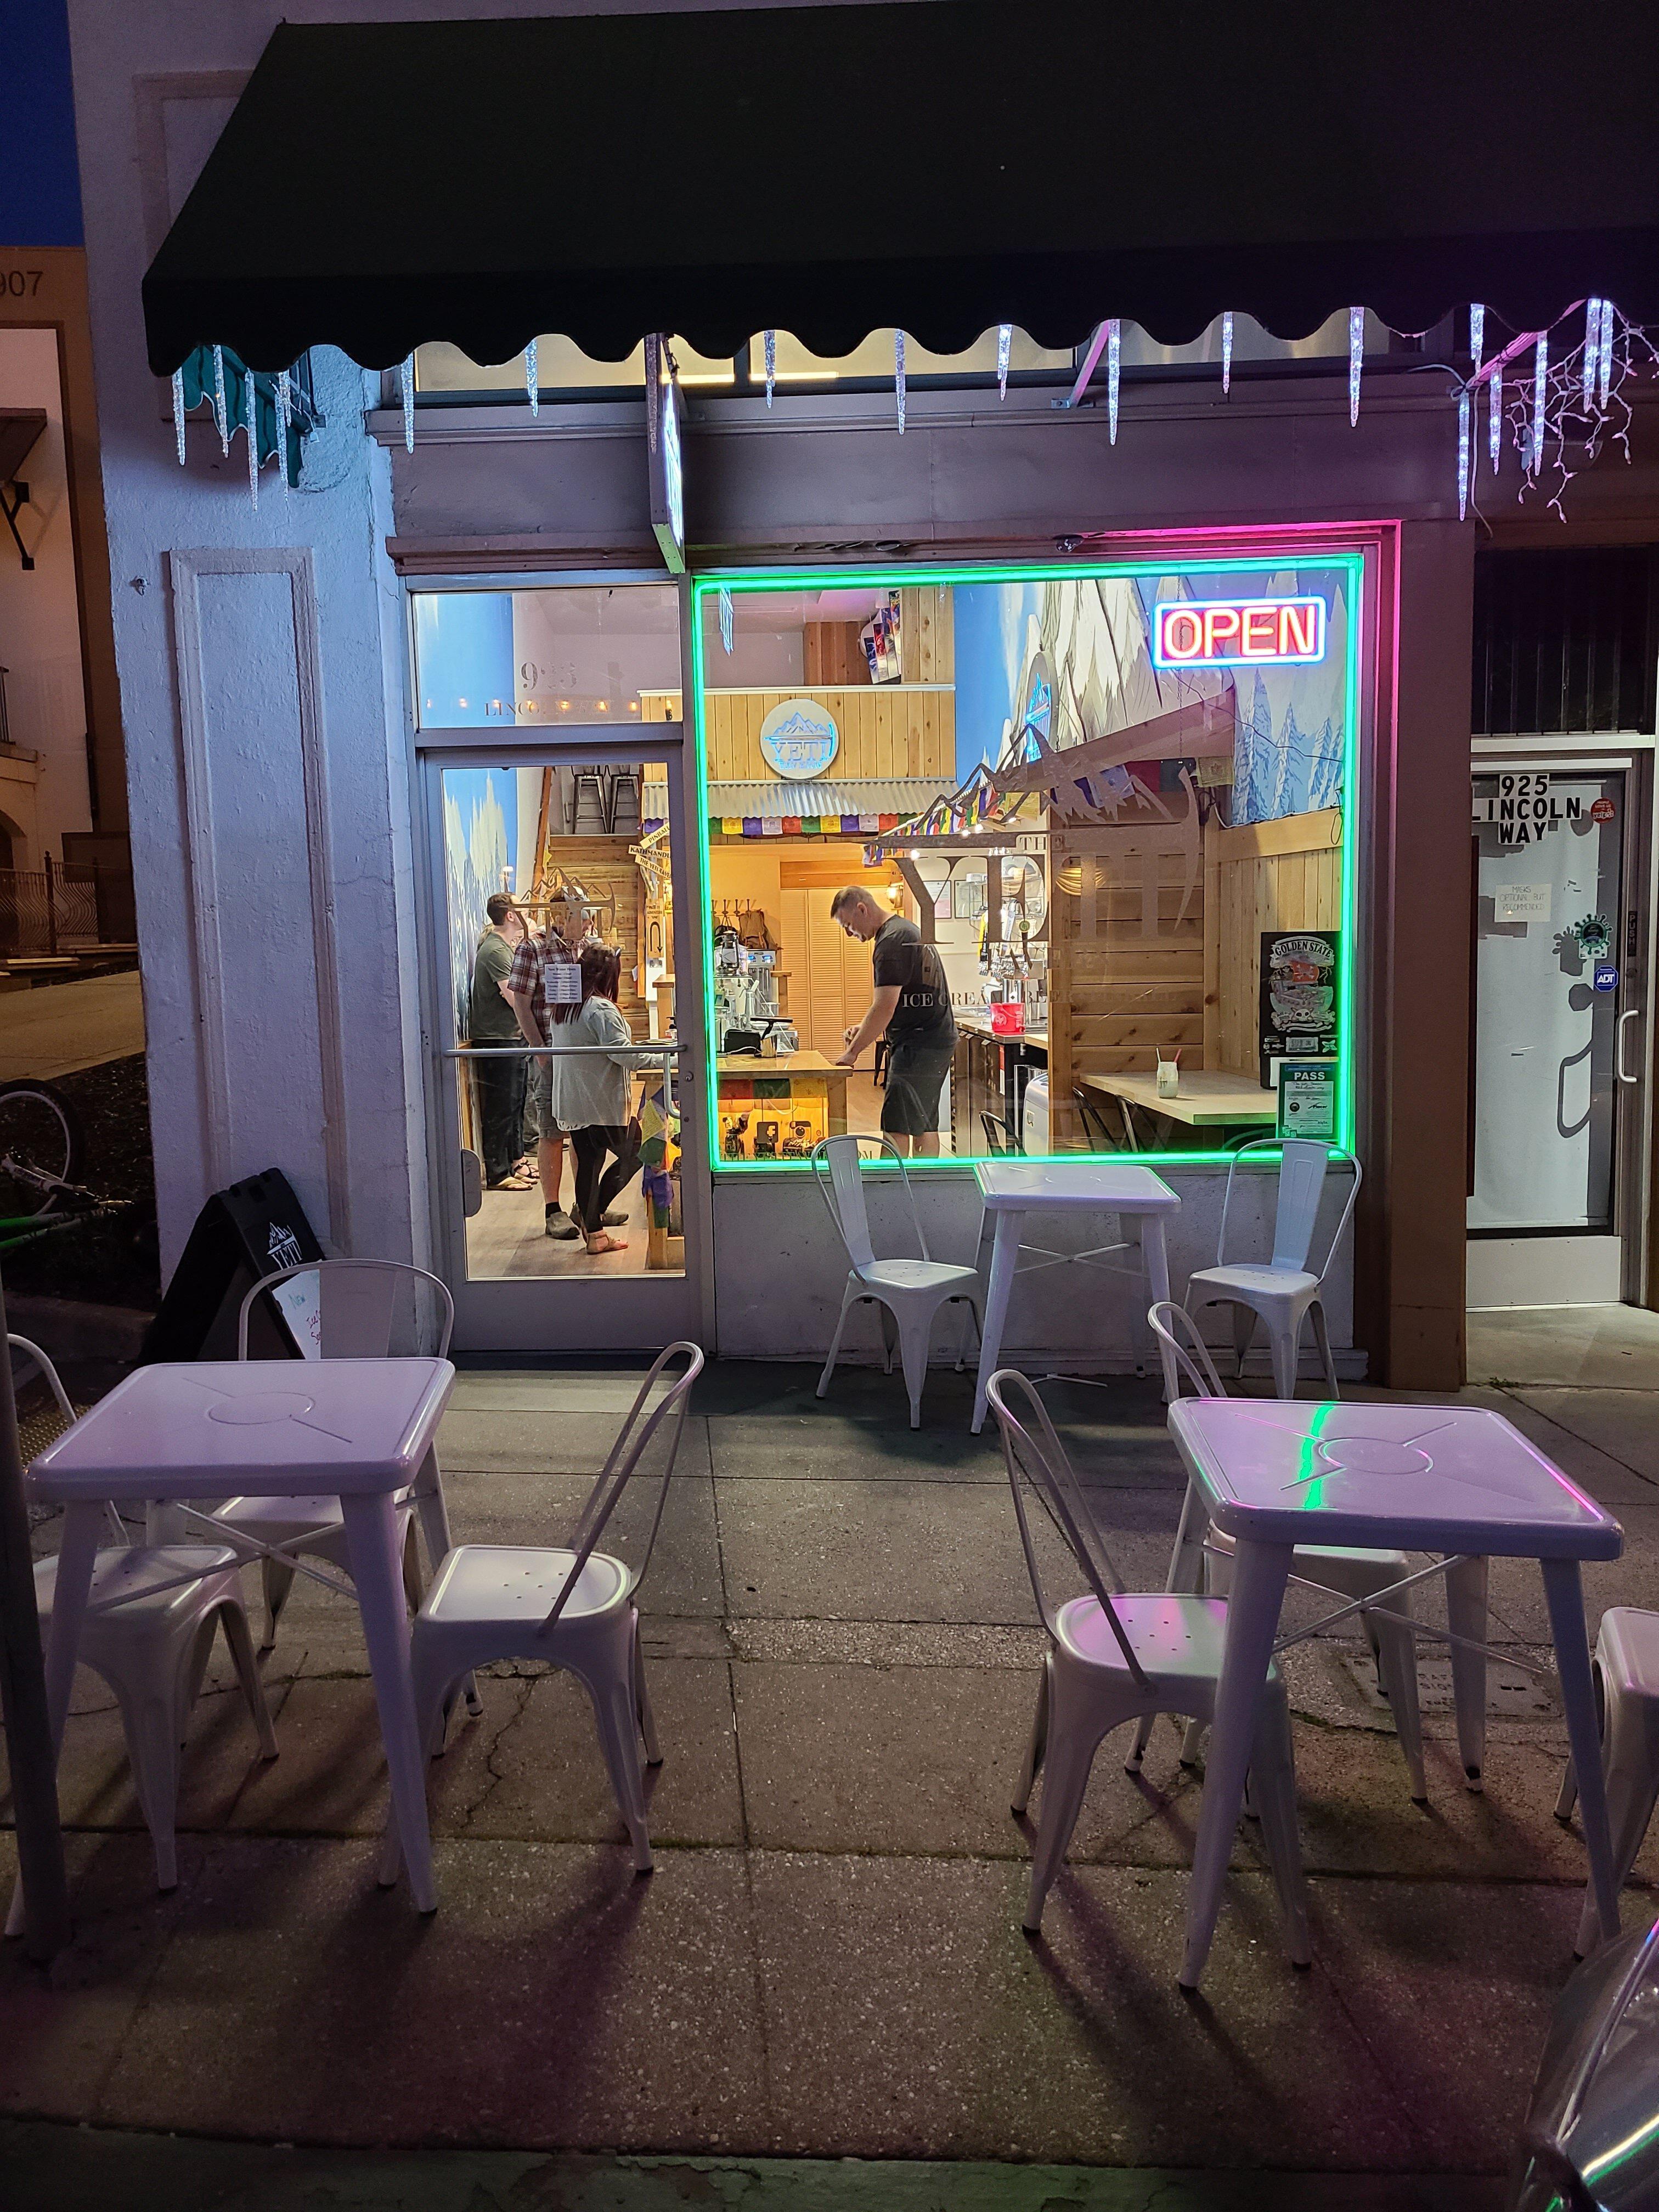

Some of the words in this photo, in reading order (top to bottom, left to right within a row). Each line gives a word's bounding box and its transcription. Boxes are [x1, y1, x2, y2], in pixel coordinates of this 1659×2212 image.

[1164, 604, 1316, 659] OPEN
[770, 741, 828, 761] YETI
[1501, 775, 1548, 797] 925
[1593, 811, 1607, 820] yelp
[1499, 821, 1548, 844] WAY
[1019, 836, 1064, 850] THE
[640, 857, 648, 866] THE
[650, 862, 659, 872] YETI
[659, 868, 671, 878] TAVE
[1274, 941, 1308, 956] GOLDEN
[1308, 942, 1333, 958] STATE
[1597, 973, 1615, 984] ADT
[901, 993, 934, 1008] ICE
[938, 991, 1004, 1007] CREAM
[1294, 1071, 1325, 1080] PASS
[272, 1243, 303, 1270] YETI
